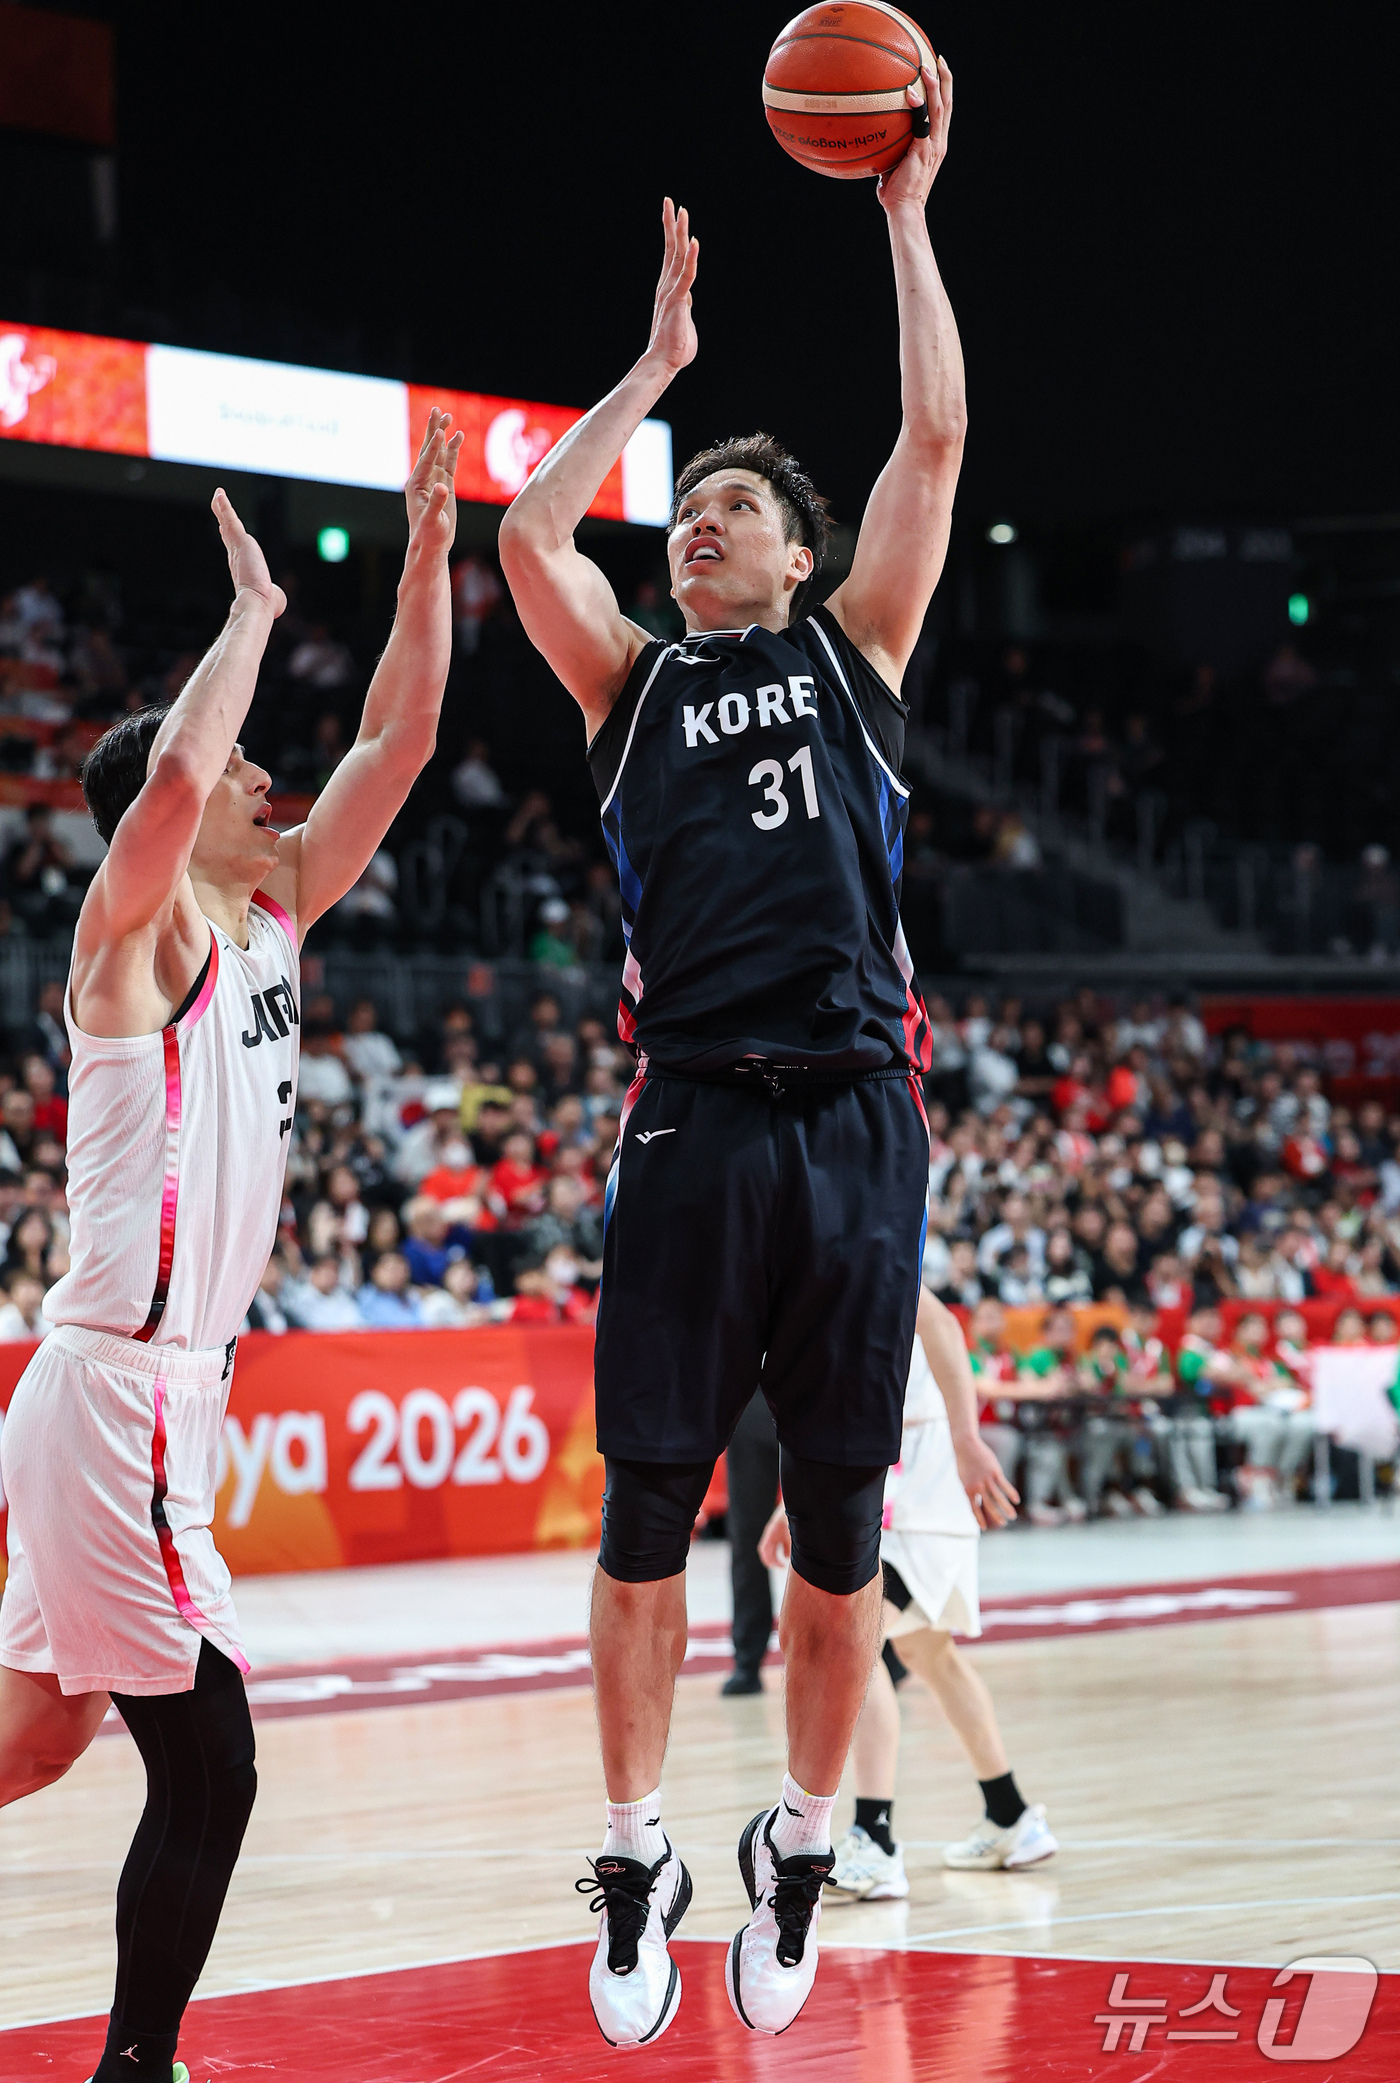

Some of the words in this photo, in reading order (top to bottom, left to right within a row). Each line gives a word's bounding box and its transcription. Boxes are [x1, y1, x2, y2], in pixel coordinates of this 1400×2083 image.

[798, 129, 887, 149] Aichi-Nagoya
[682, 676, 818, 748] KORE
[748, 745, 821, 831] 31
[347, 1385, 550, 1490] 2026
